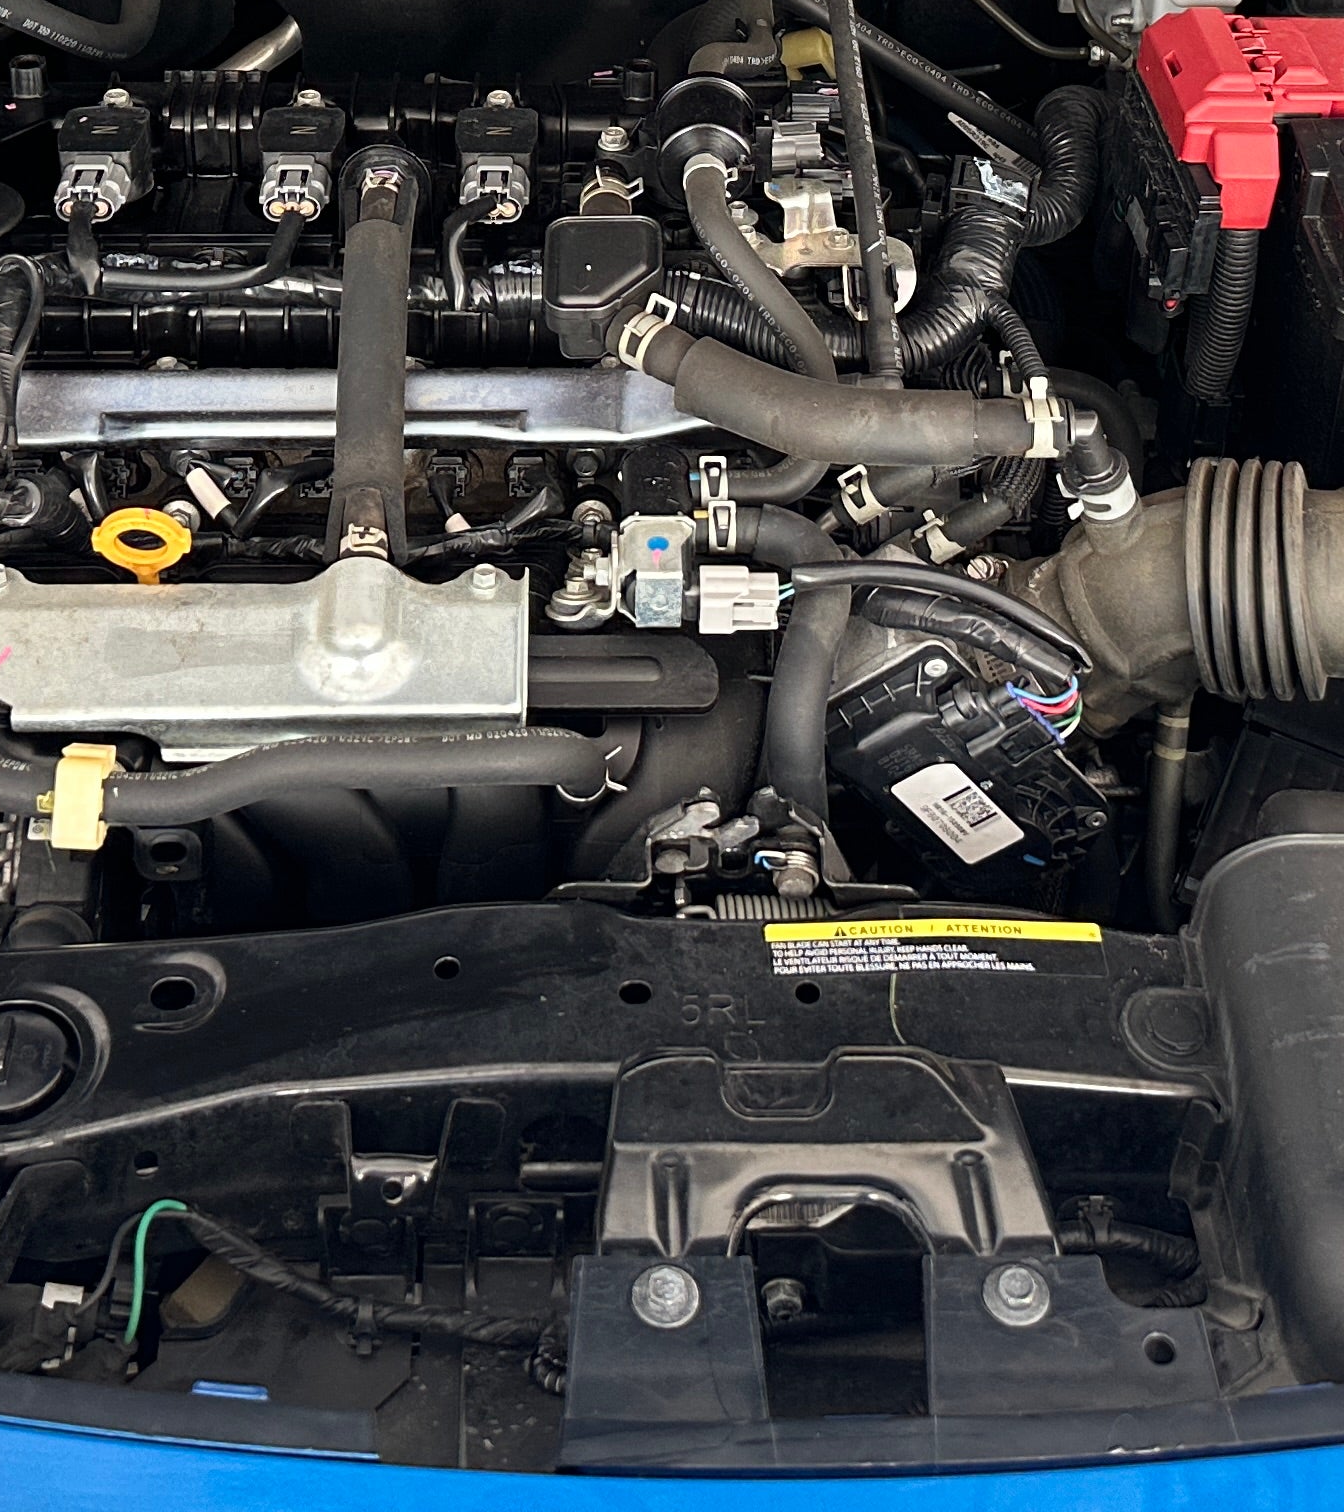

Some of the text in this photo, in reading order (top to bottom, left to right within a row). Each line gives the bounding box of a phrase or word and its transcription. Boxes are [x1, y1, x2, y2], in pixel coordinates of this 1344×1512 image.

[849, 924, 914, 935] CAUTION
[946, 924, 1022, 935] ATTENTION
[784, 949, 804, 957] HELP
[773, 966, 797, 974] POUR
